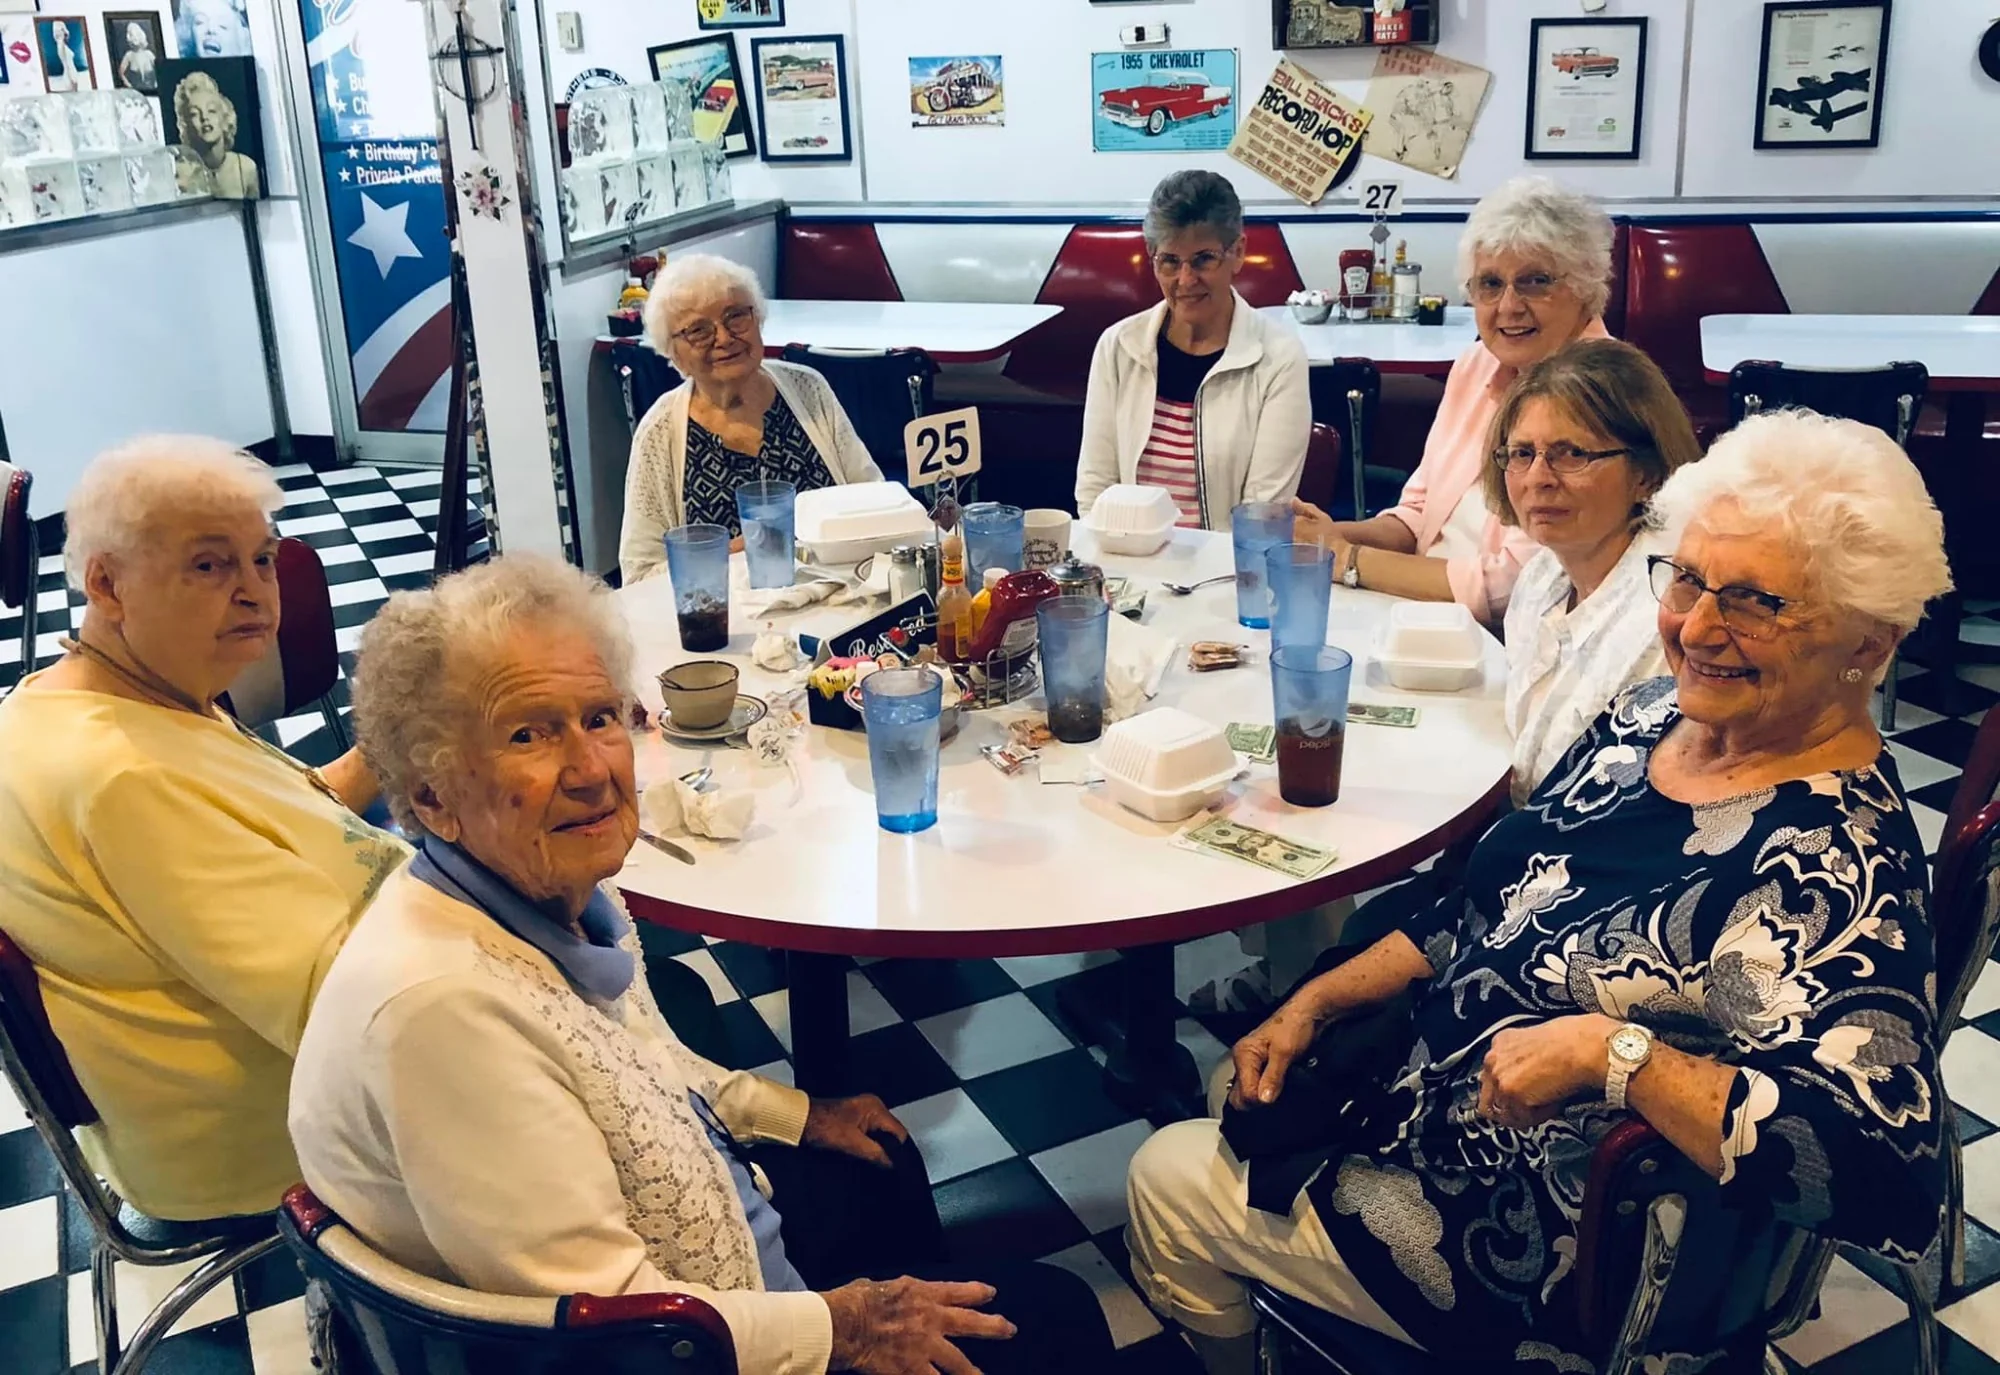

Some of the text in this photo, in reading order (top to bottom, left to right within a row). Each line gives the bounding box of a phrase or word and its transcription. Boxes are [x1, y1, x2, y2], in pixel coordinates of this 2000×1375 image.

[1376, 31, 1398, 40] OATS
[1121, 54, 1143, 70] 1955
[1149, 52, 1206, 69] CHEVROLET
[1271, 67, 1364, 134] BILL BLACK'S
[1257, 83, 1320, 134] RECORD
[1311, 119, 1355, 156] HOP
[364, 142, 418, 165] Birthday
[356, 166, 401, 186] Private
[1365, 184, 1398, 209] 27
[916, 420, 969, 475] 25
[847, 605, 927, 659] Reseed
[1299, 738, 1331, 751] pepsi
